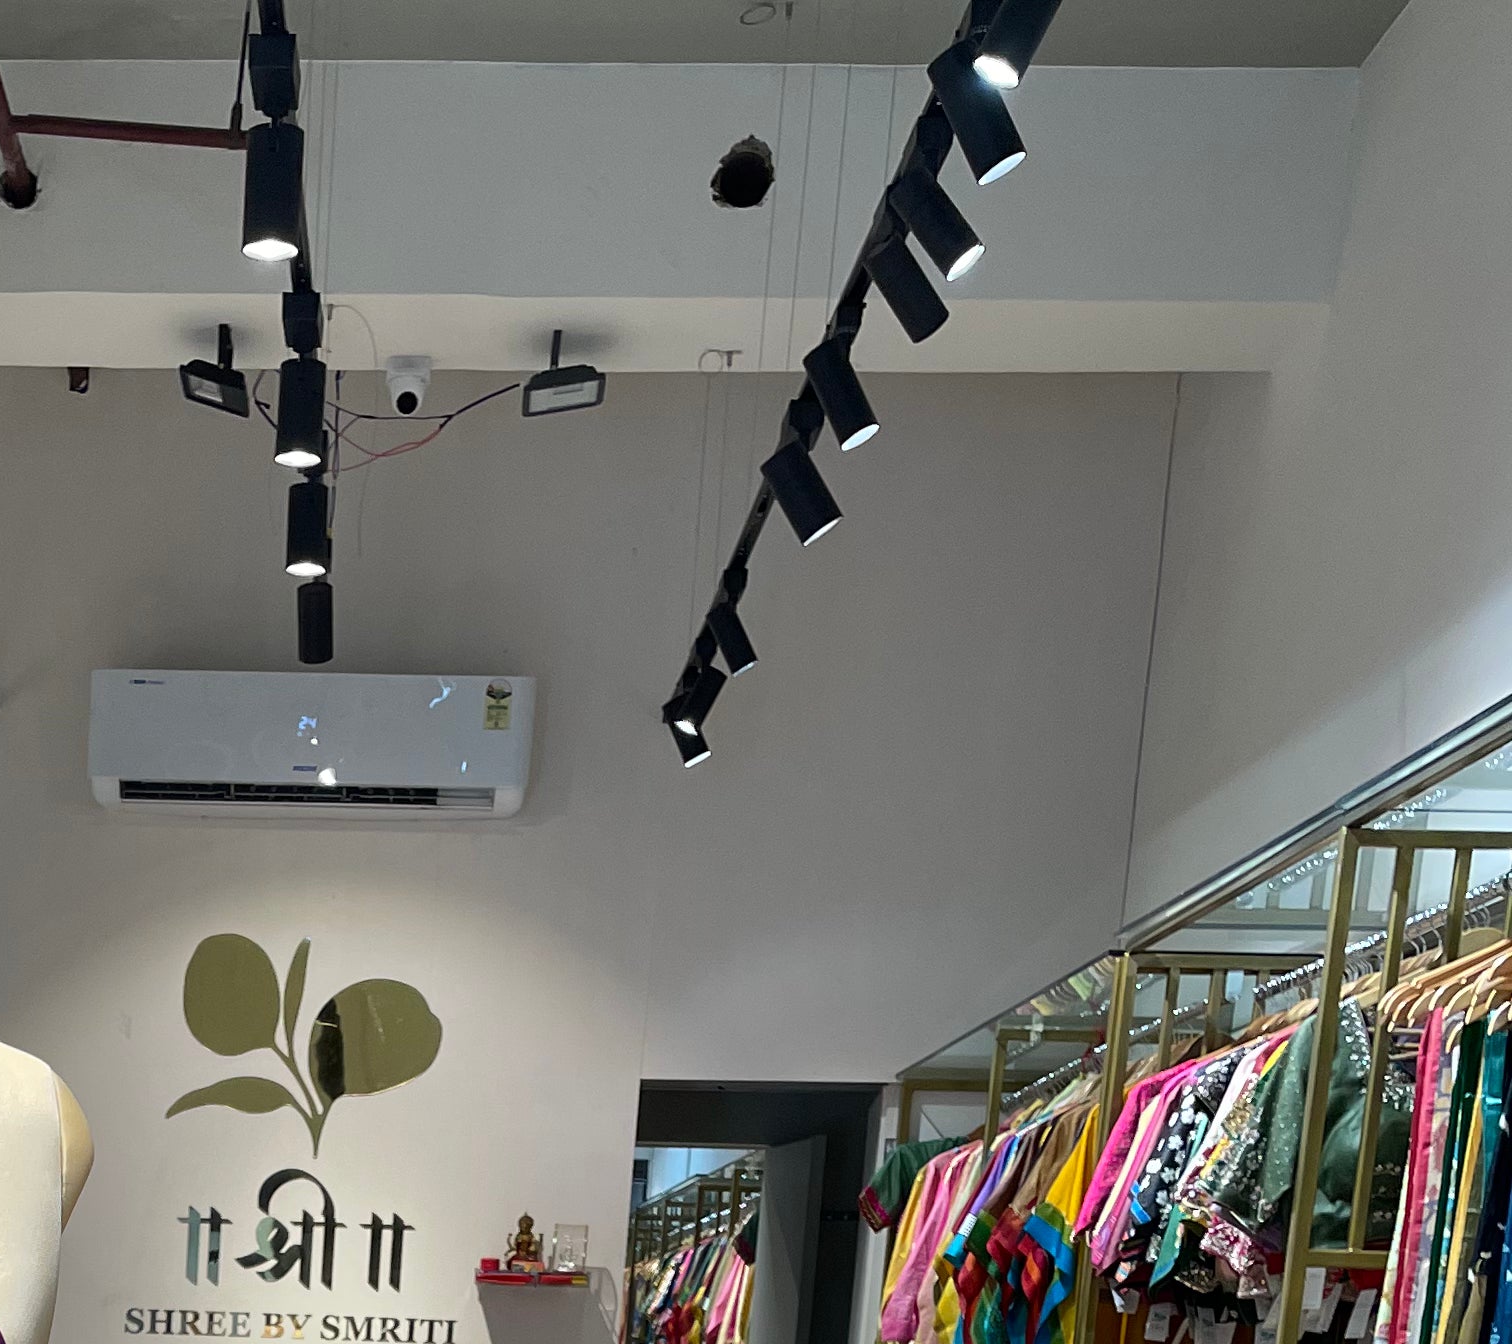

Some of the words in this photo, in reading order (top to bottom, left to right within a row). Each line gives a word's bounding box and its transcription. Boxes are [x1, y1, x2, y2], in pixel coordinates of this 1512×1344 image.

[235, 1168, 347, 1290] श्री
[124, 1307, 251, 1338] SHREE
[260, 1312, 313, 1340] BY
[319, 1314, 458, 1344] SMRITI
